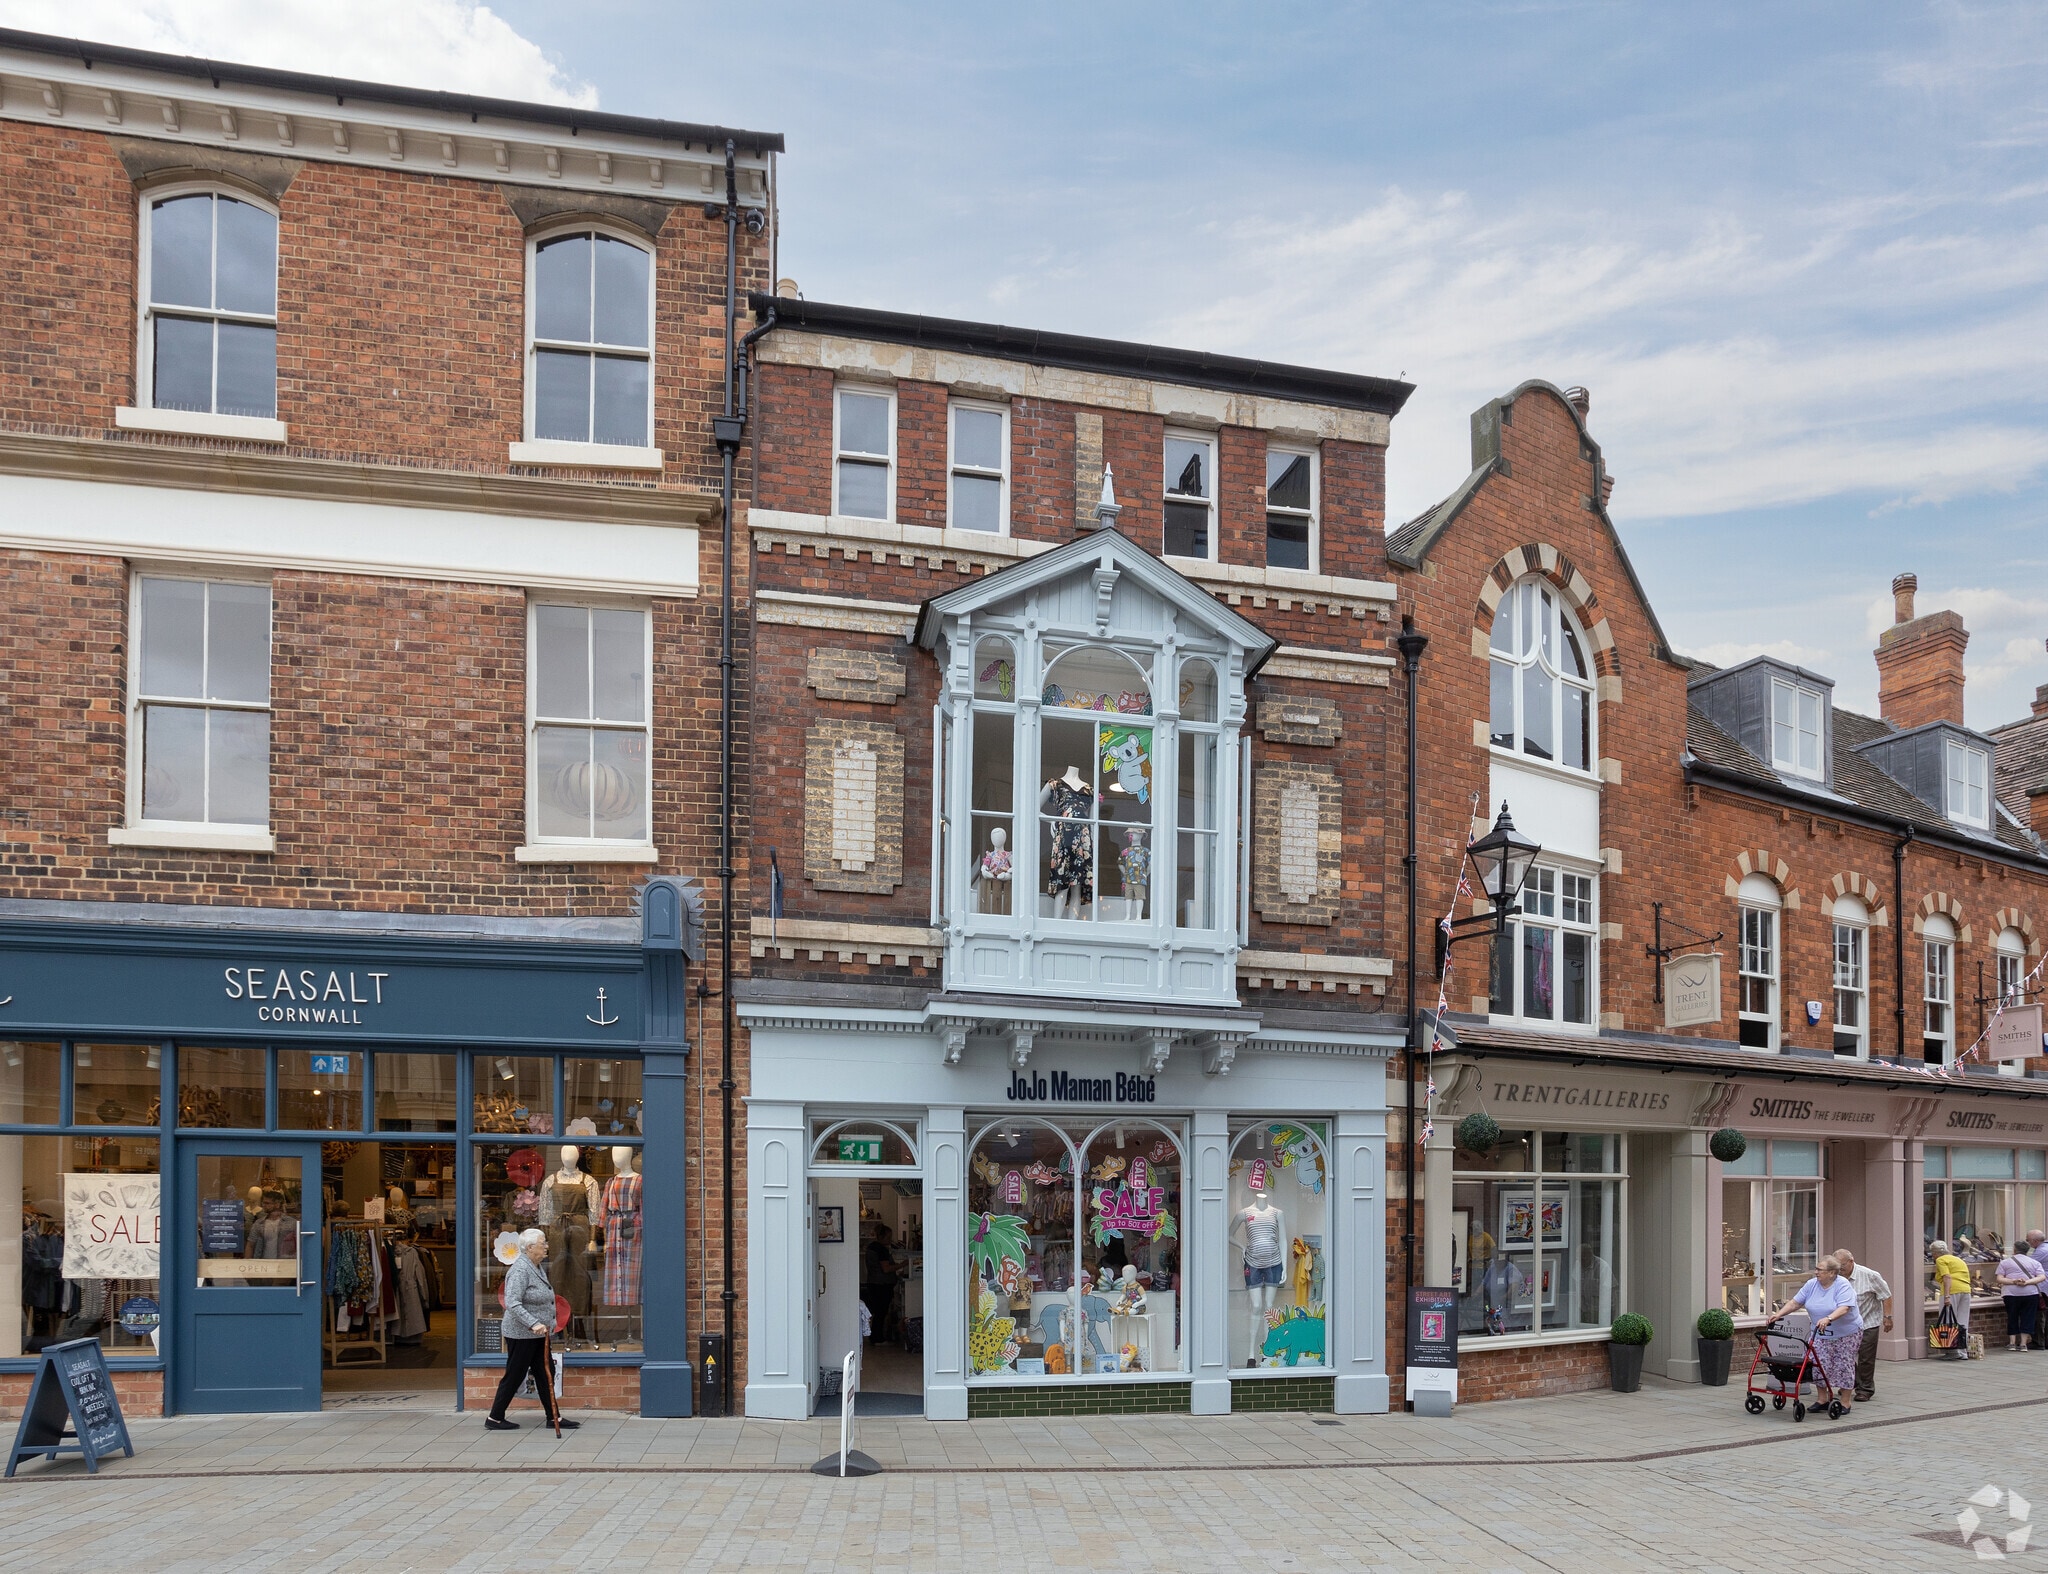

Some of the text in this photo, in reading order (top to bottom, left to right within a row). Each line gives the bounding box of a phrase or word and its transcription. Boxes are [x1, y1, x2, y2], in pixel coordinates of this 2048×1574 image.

[224, 967, 389, 1004] SEASALT
[1675, 1001, 1709, 1012] GALLERIES
[1676, 991, 1707, 1004] TRENT
[258, 1006, 362, 1024] CORNWALL
[1998, 1030, 2032, 1041] SMITHS
[1006, 1070, 1155, 1102] JoJo Maman Bébé
[1750, 1097, 1876, 1123] SMITHS THE JEWELLERS
[1946, 1110, 2044, 1133] SMITHS THE JEWELLERS
[1134, 1161, 1145, 1187] SALE
[1251, 1161, 1265, 1188] SALE
[1008, 1175, 1019, 1201] SALE
[1099, 1187, 1165, 1218] SALE
[1106, 1220, 1116, 1229] Up
[1142, 1221, 1154, 1229] off
[238, 1265, 268, 1273] OPEN
[71, 1359, 91, 1371] SEASALT
[81, 1373, 90, 1384] OFF
